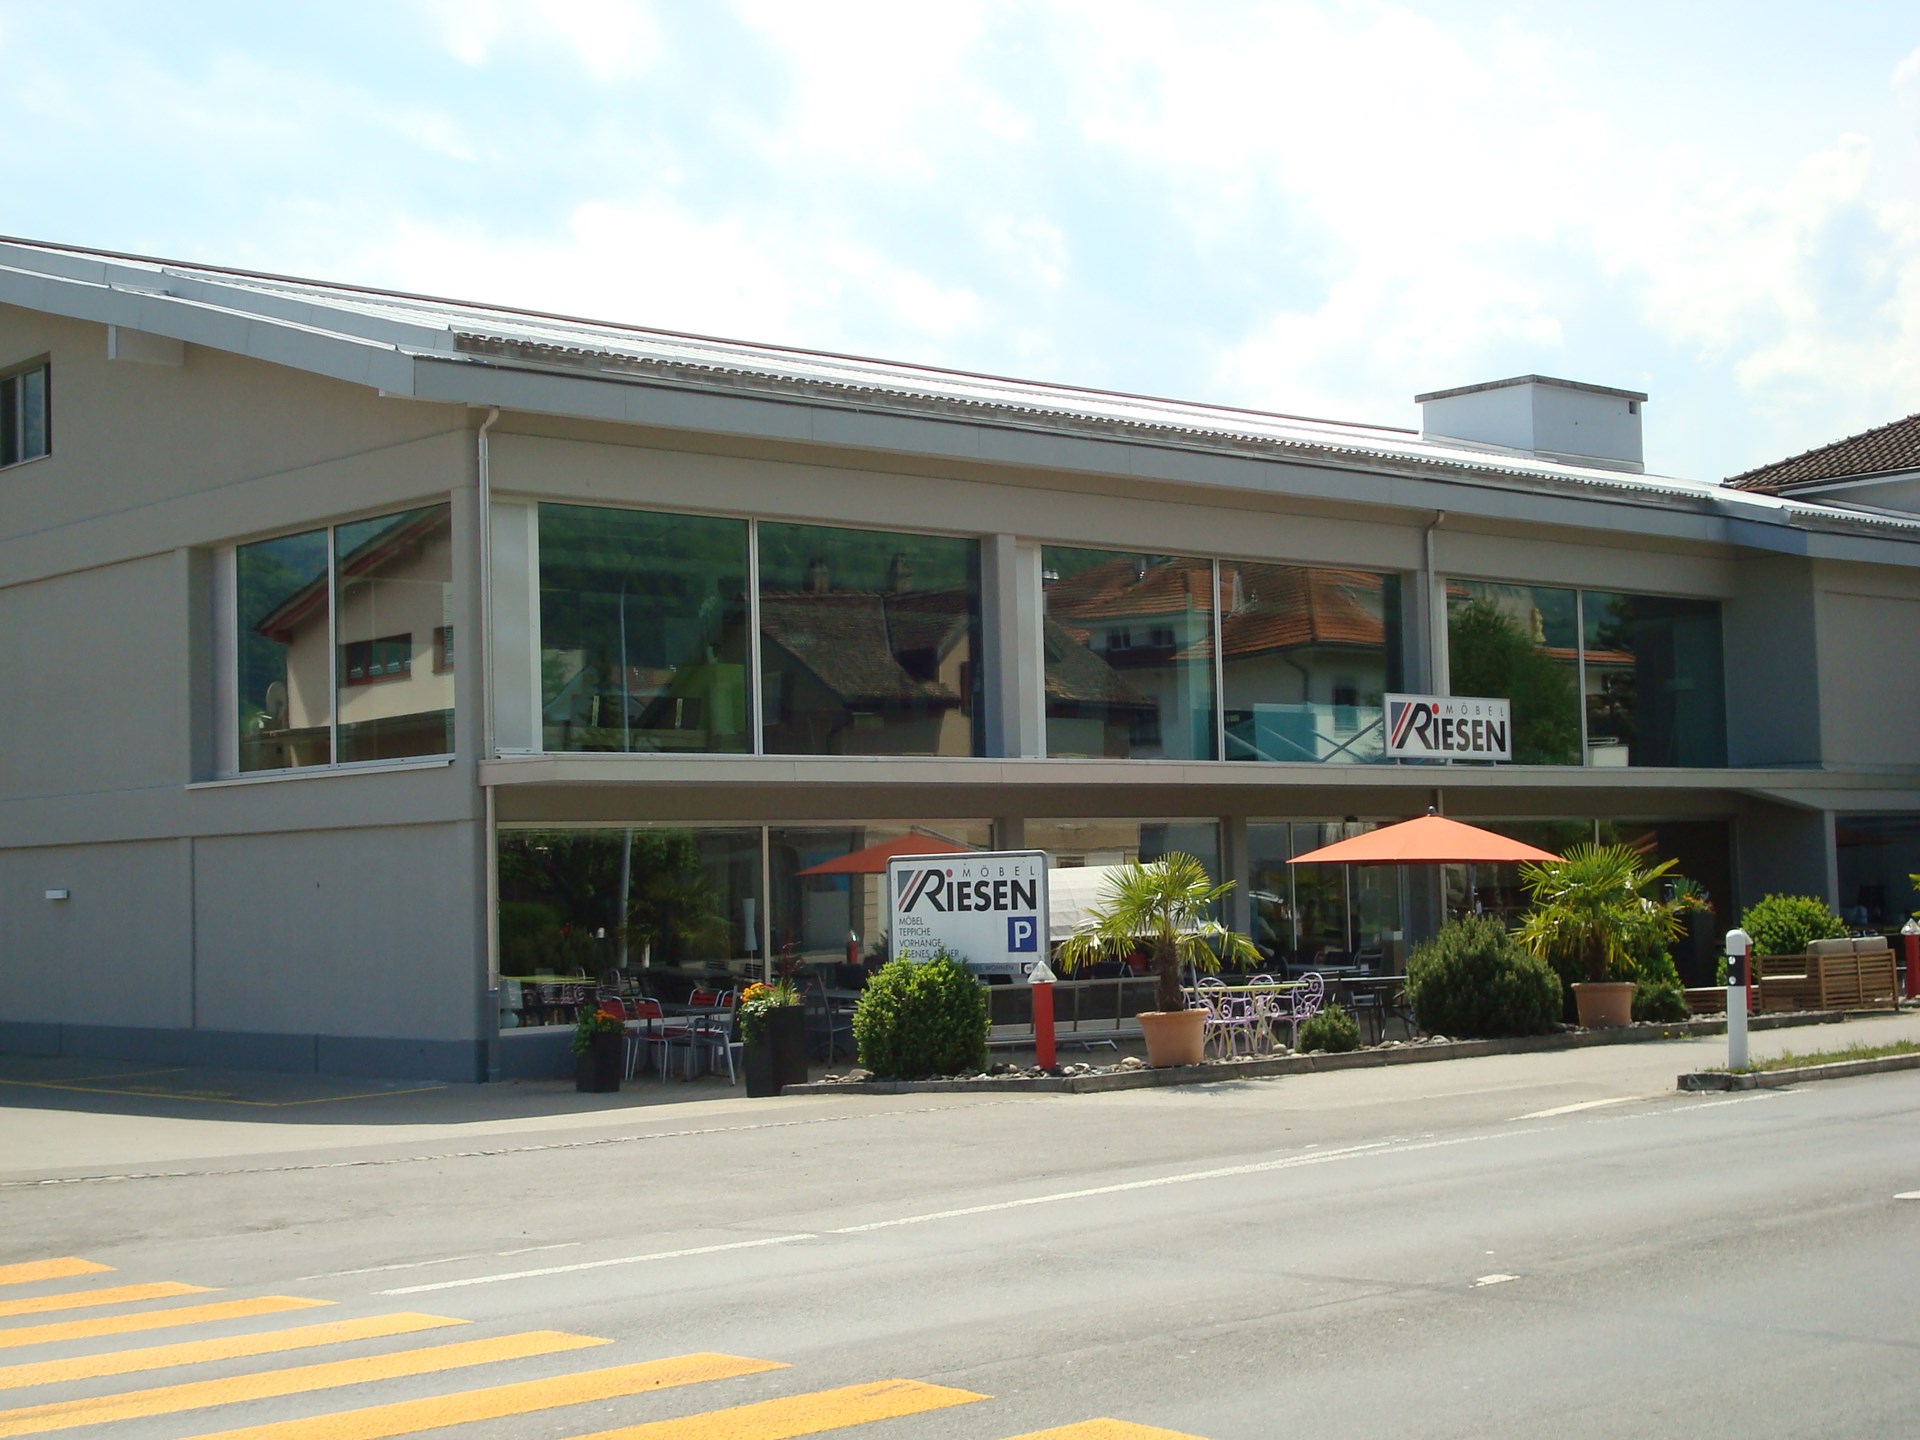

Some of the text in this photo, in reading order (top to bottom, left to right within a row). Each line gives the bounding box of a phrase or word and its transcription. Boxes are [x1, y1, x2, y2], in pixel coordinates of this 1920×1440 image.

[1445, 703, 1504, 717] MÖBEL
[962, 865, 1035, 878] MÖBEL
[898, 915, 924, 926] MÖBEL
[898, 927, 931, 937] TEPPICHE
[1014, 921, 1032, 948] P
[898, 937, 942, 948] VORHÄNGE
[898, 949, 930, 959] EGENES
